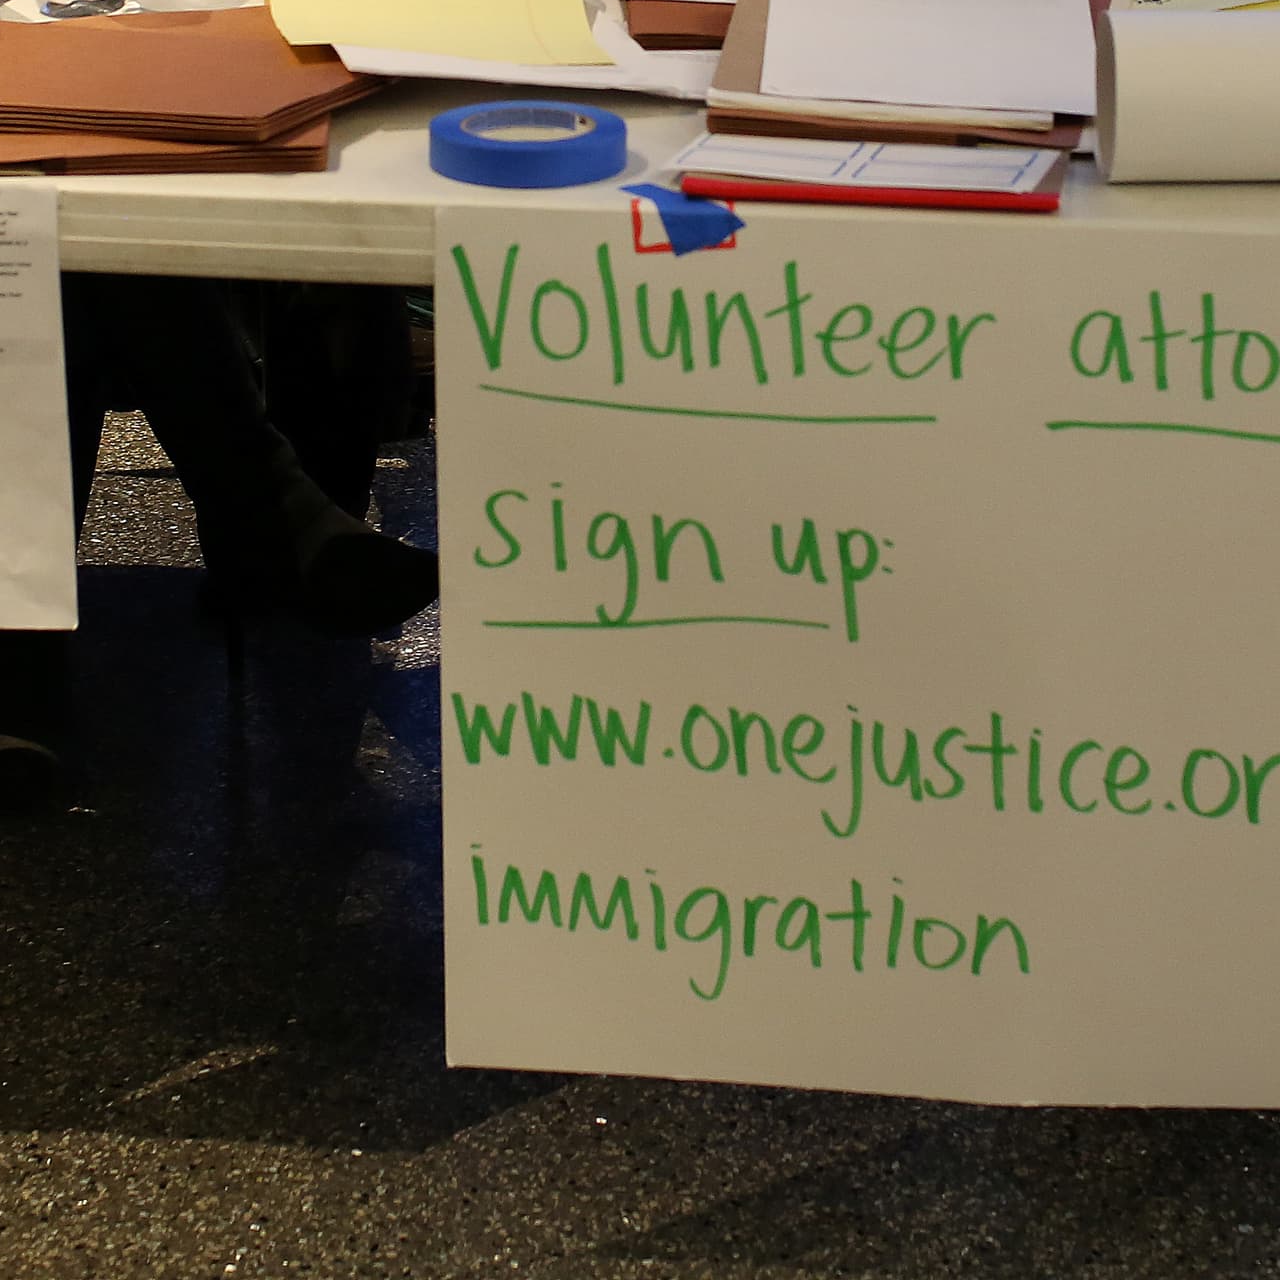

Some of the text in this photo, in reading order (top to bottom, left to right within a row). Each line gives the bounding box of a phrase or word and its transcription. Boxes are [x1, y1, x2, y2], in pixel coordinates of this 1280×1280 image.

[452, 244, 995, 385] Volunteer
[475, 483, 895, 642] sign up:
[471, 844, 1030, 1000] immigration
